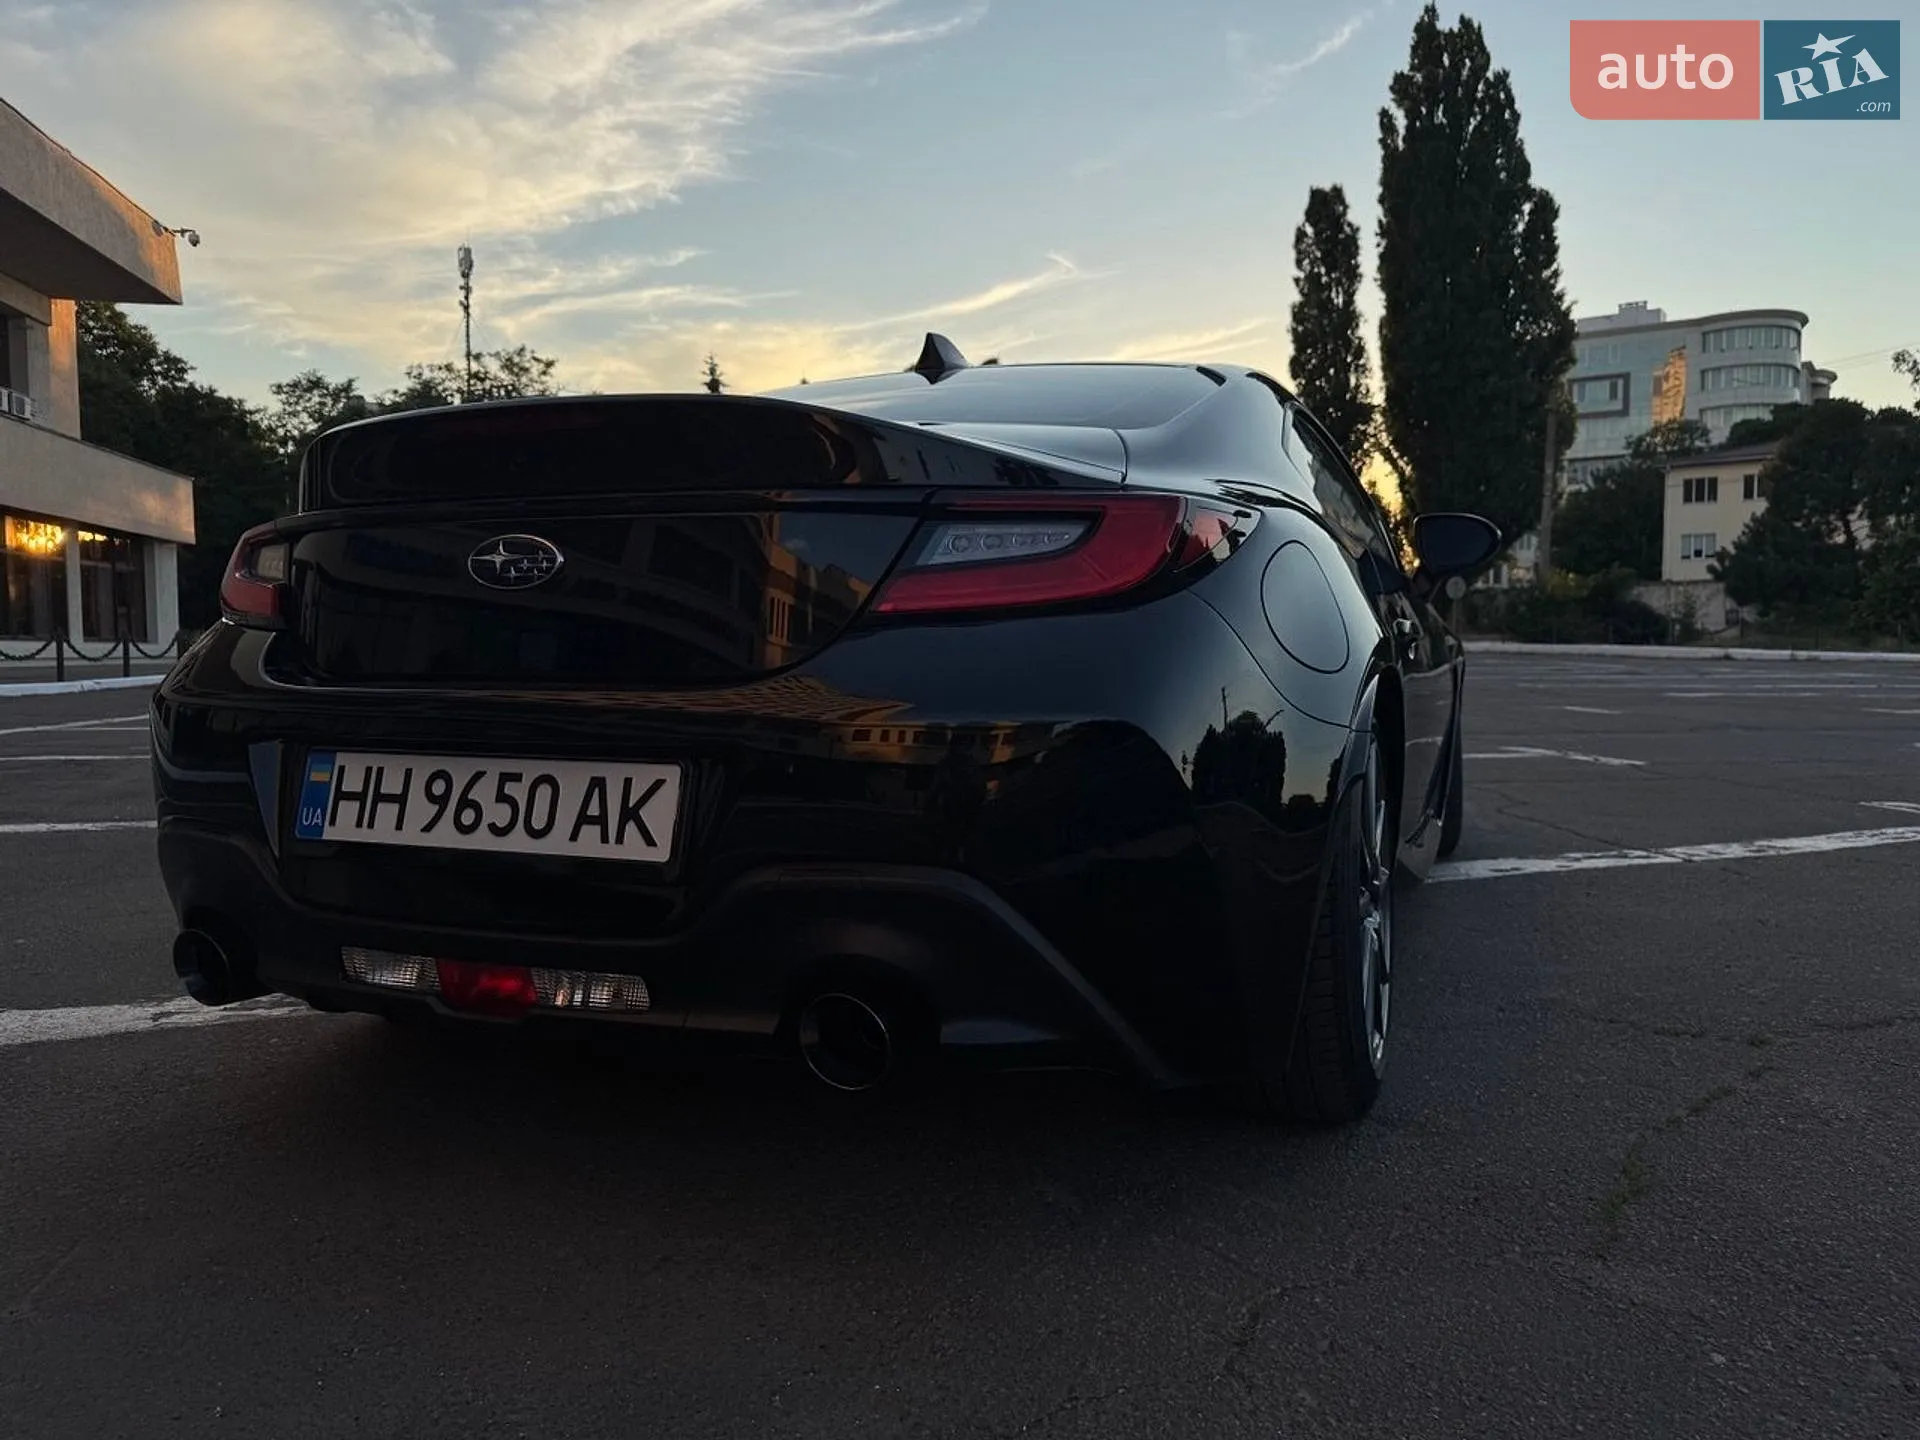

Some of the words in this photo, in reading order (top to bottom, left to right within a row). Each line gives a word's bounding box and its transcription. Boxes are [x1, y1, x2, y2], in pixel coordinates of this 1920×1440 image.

[302, 807, 323, 827] UA
[329, 765, 413, 830] HH
[420, 768, 561, 840] 9650
[568, 776, 667, 847] AK
